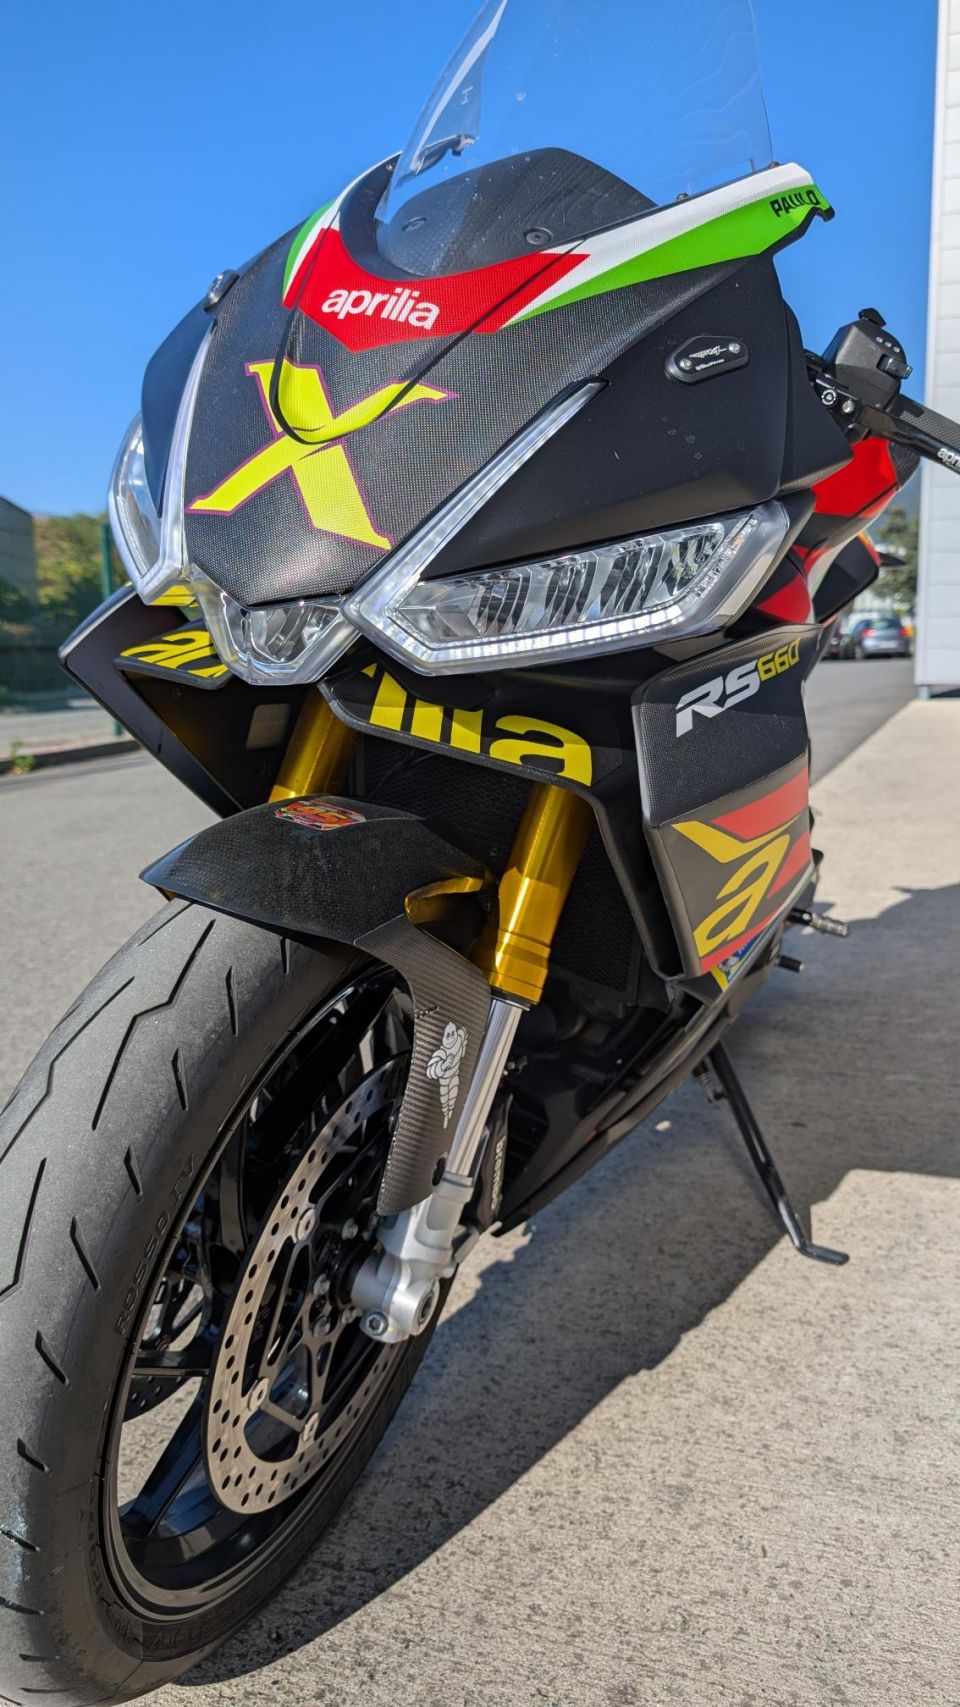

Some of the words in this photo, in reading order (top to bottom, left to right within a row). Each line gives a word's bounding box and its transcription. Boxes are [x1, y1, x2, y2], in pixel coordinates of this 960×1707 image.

[769, 189, 821, 218] PAULO
[321, 287, 440, 330] aprilia
[113, 1210, 171, 1337] ROSSO
